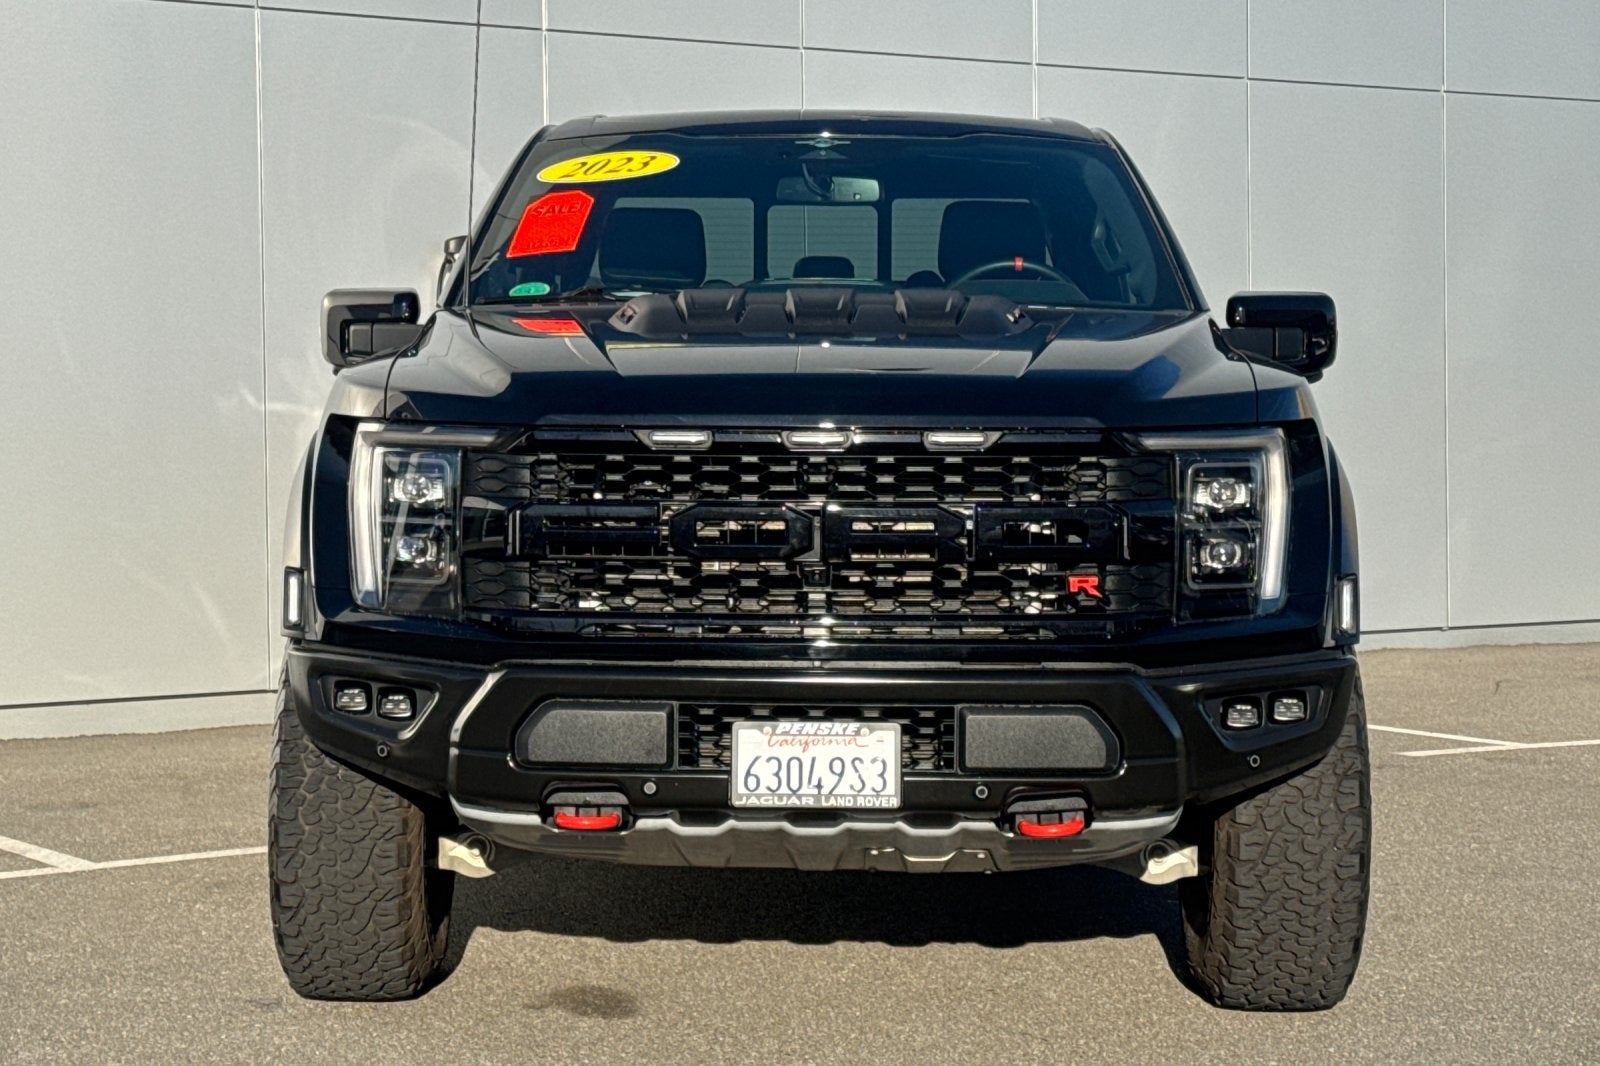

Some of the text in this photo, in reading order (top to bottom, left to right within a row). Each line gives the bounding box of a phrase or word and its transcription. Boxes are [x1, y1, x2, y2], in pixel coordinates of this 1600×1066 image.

[560, 156, 658, 178] 2023
[1068, 575, 1103, 598] R
[775, 723, 860, 734] PENSKE
[744, 756, 887, 794] 63049S3
[736, 796, 898, 807] JAGUAR LAND ROVER
